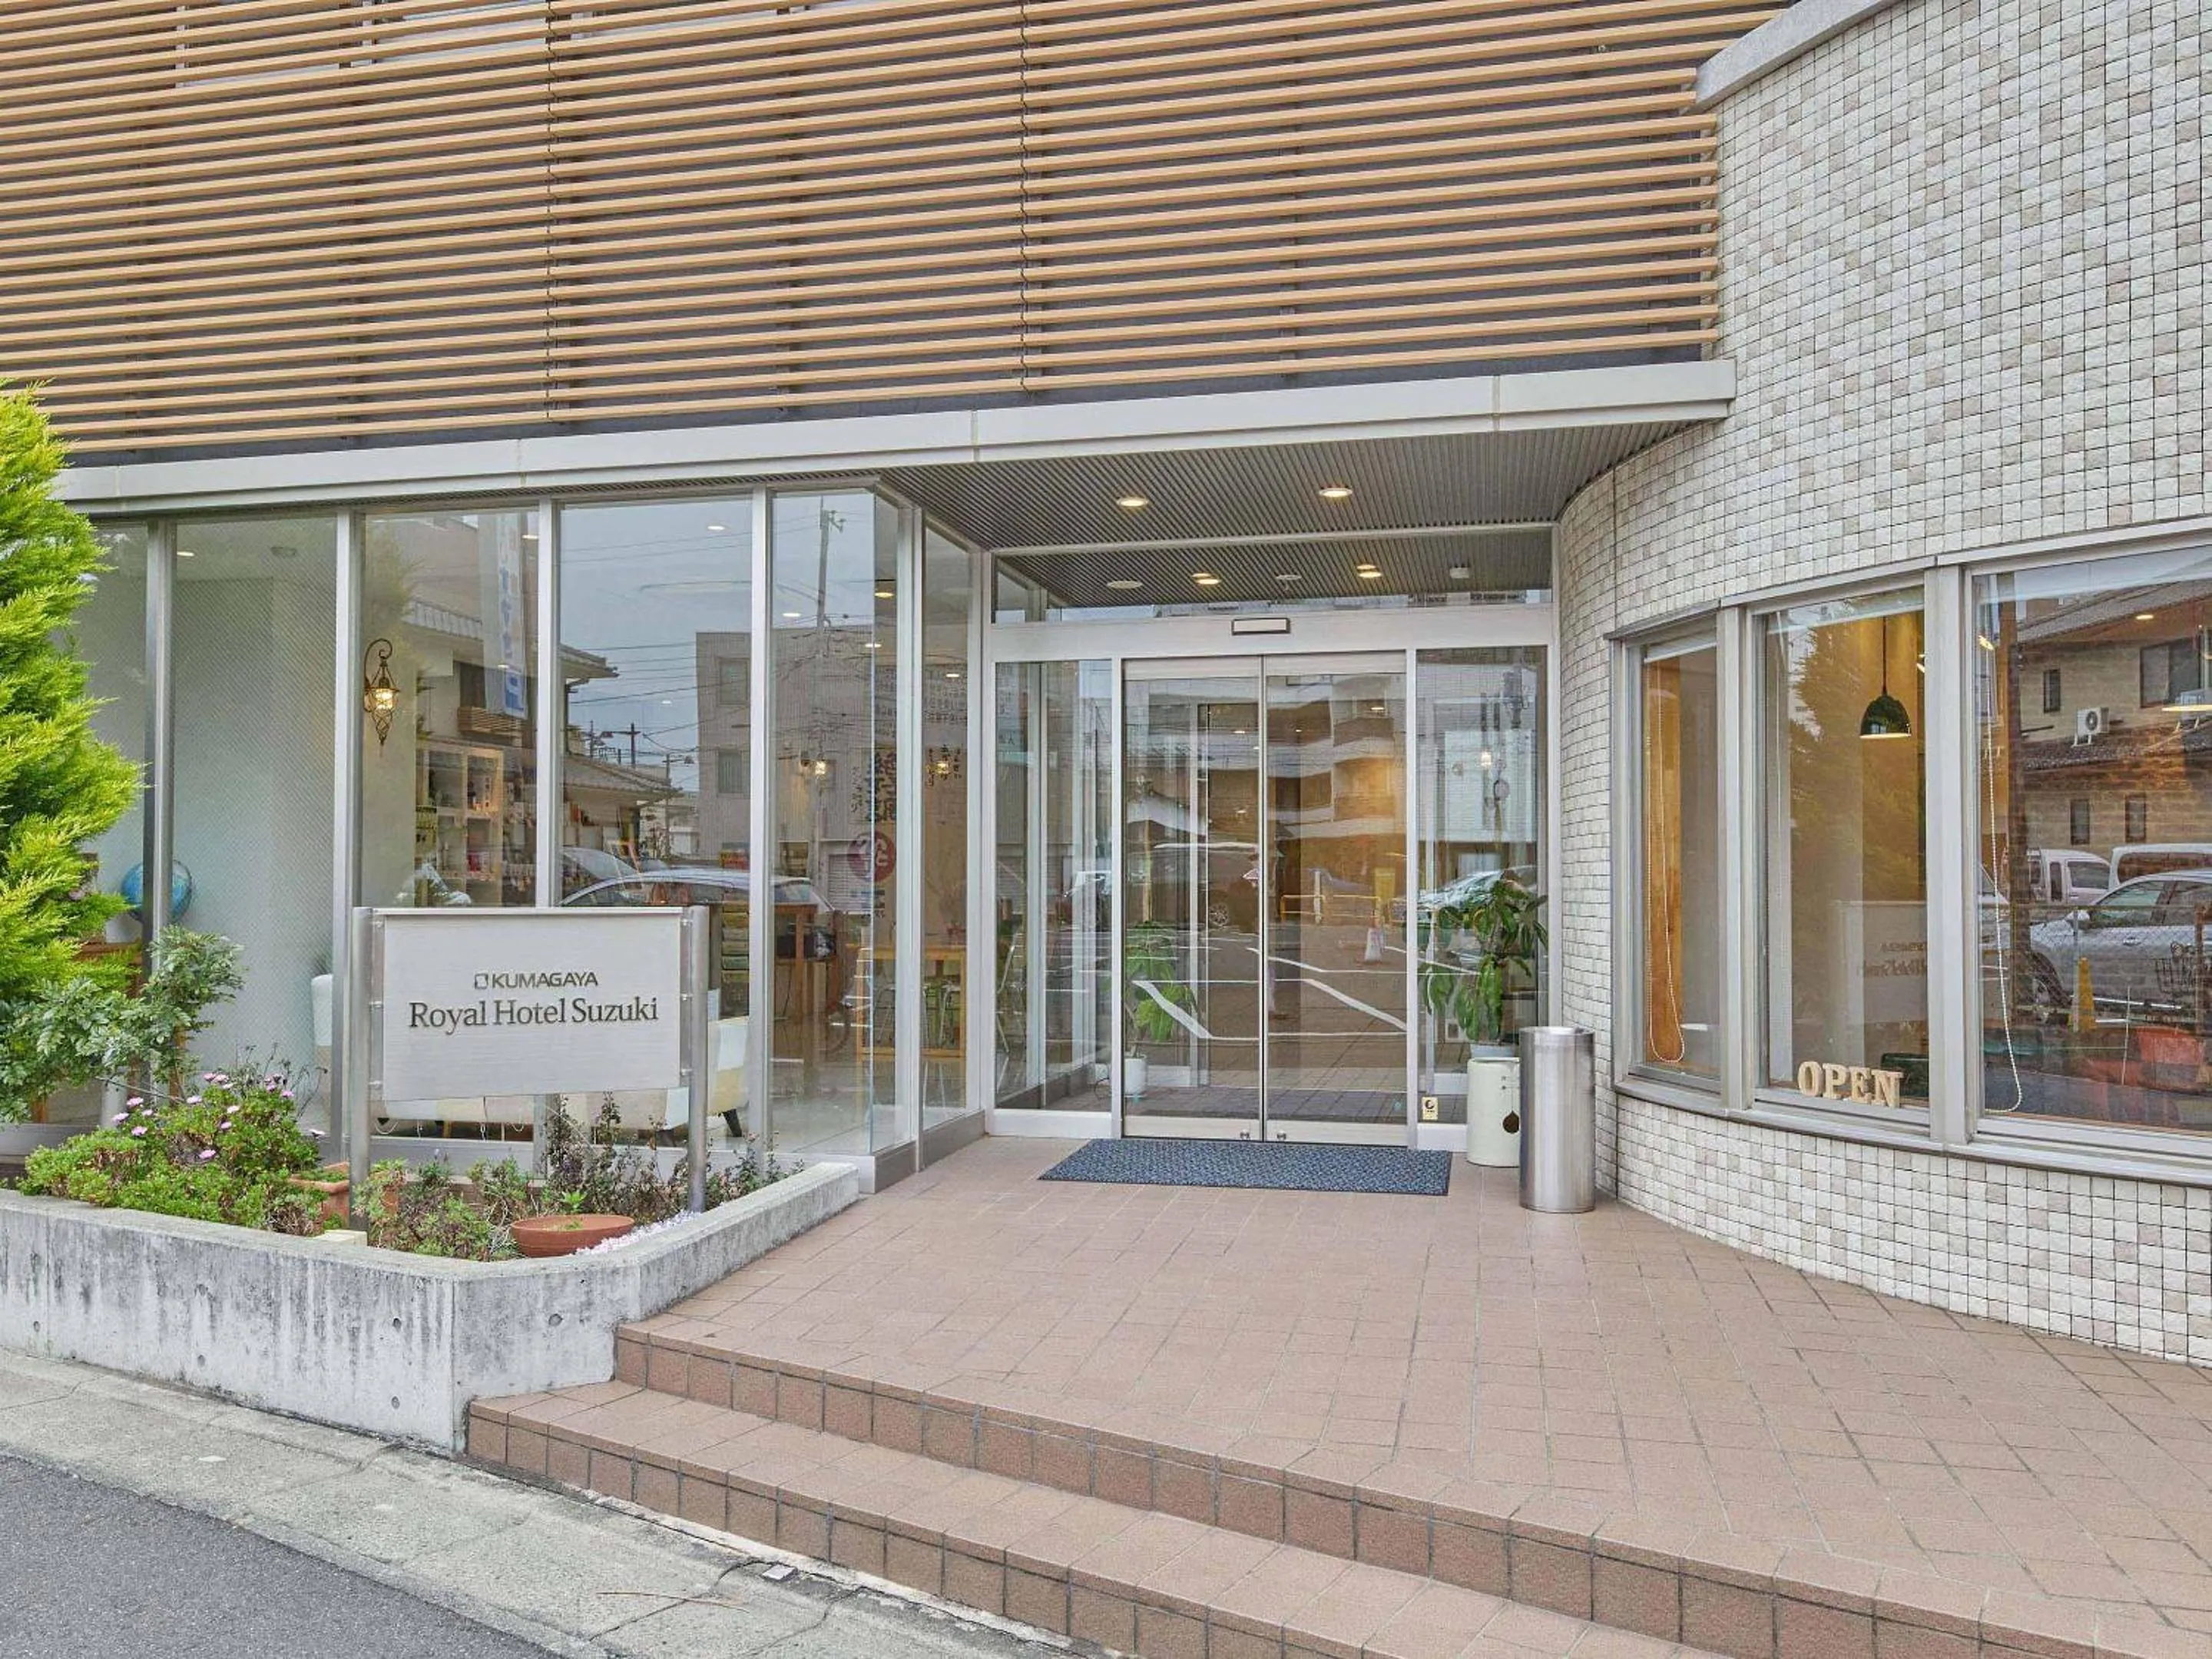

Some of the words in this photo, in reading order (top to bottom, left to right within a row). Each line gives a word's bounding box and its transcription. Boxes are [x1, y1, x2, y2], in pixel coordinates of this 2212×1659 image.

[492, 971, 598, 988] KUMAGAYA
[409, 1002, 487, 1035] Royal
[495, 999, 565, 1026] Hotel
[571, 996, 658, 1022] Suzuki
[1797, 1061, 1903, 1108] OPEN
